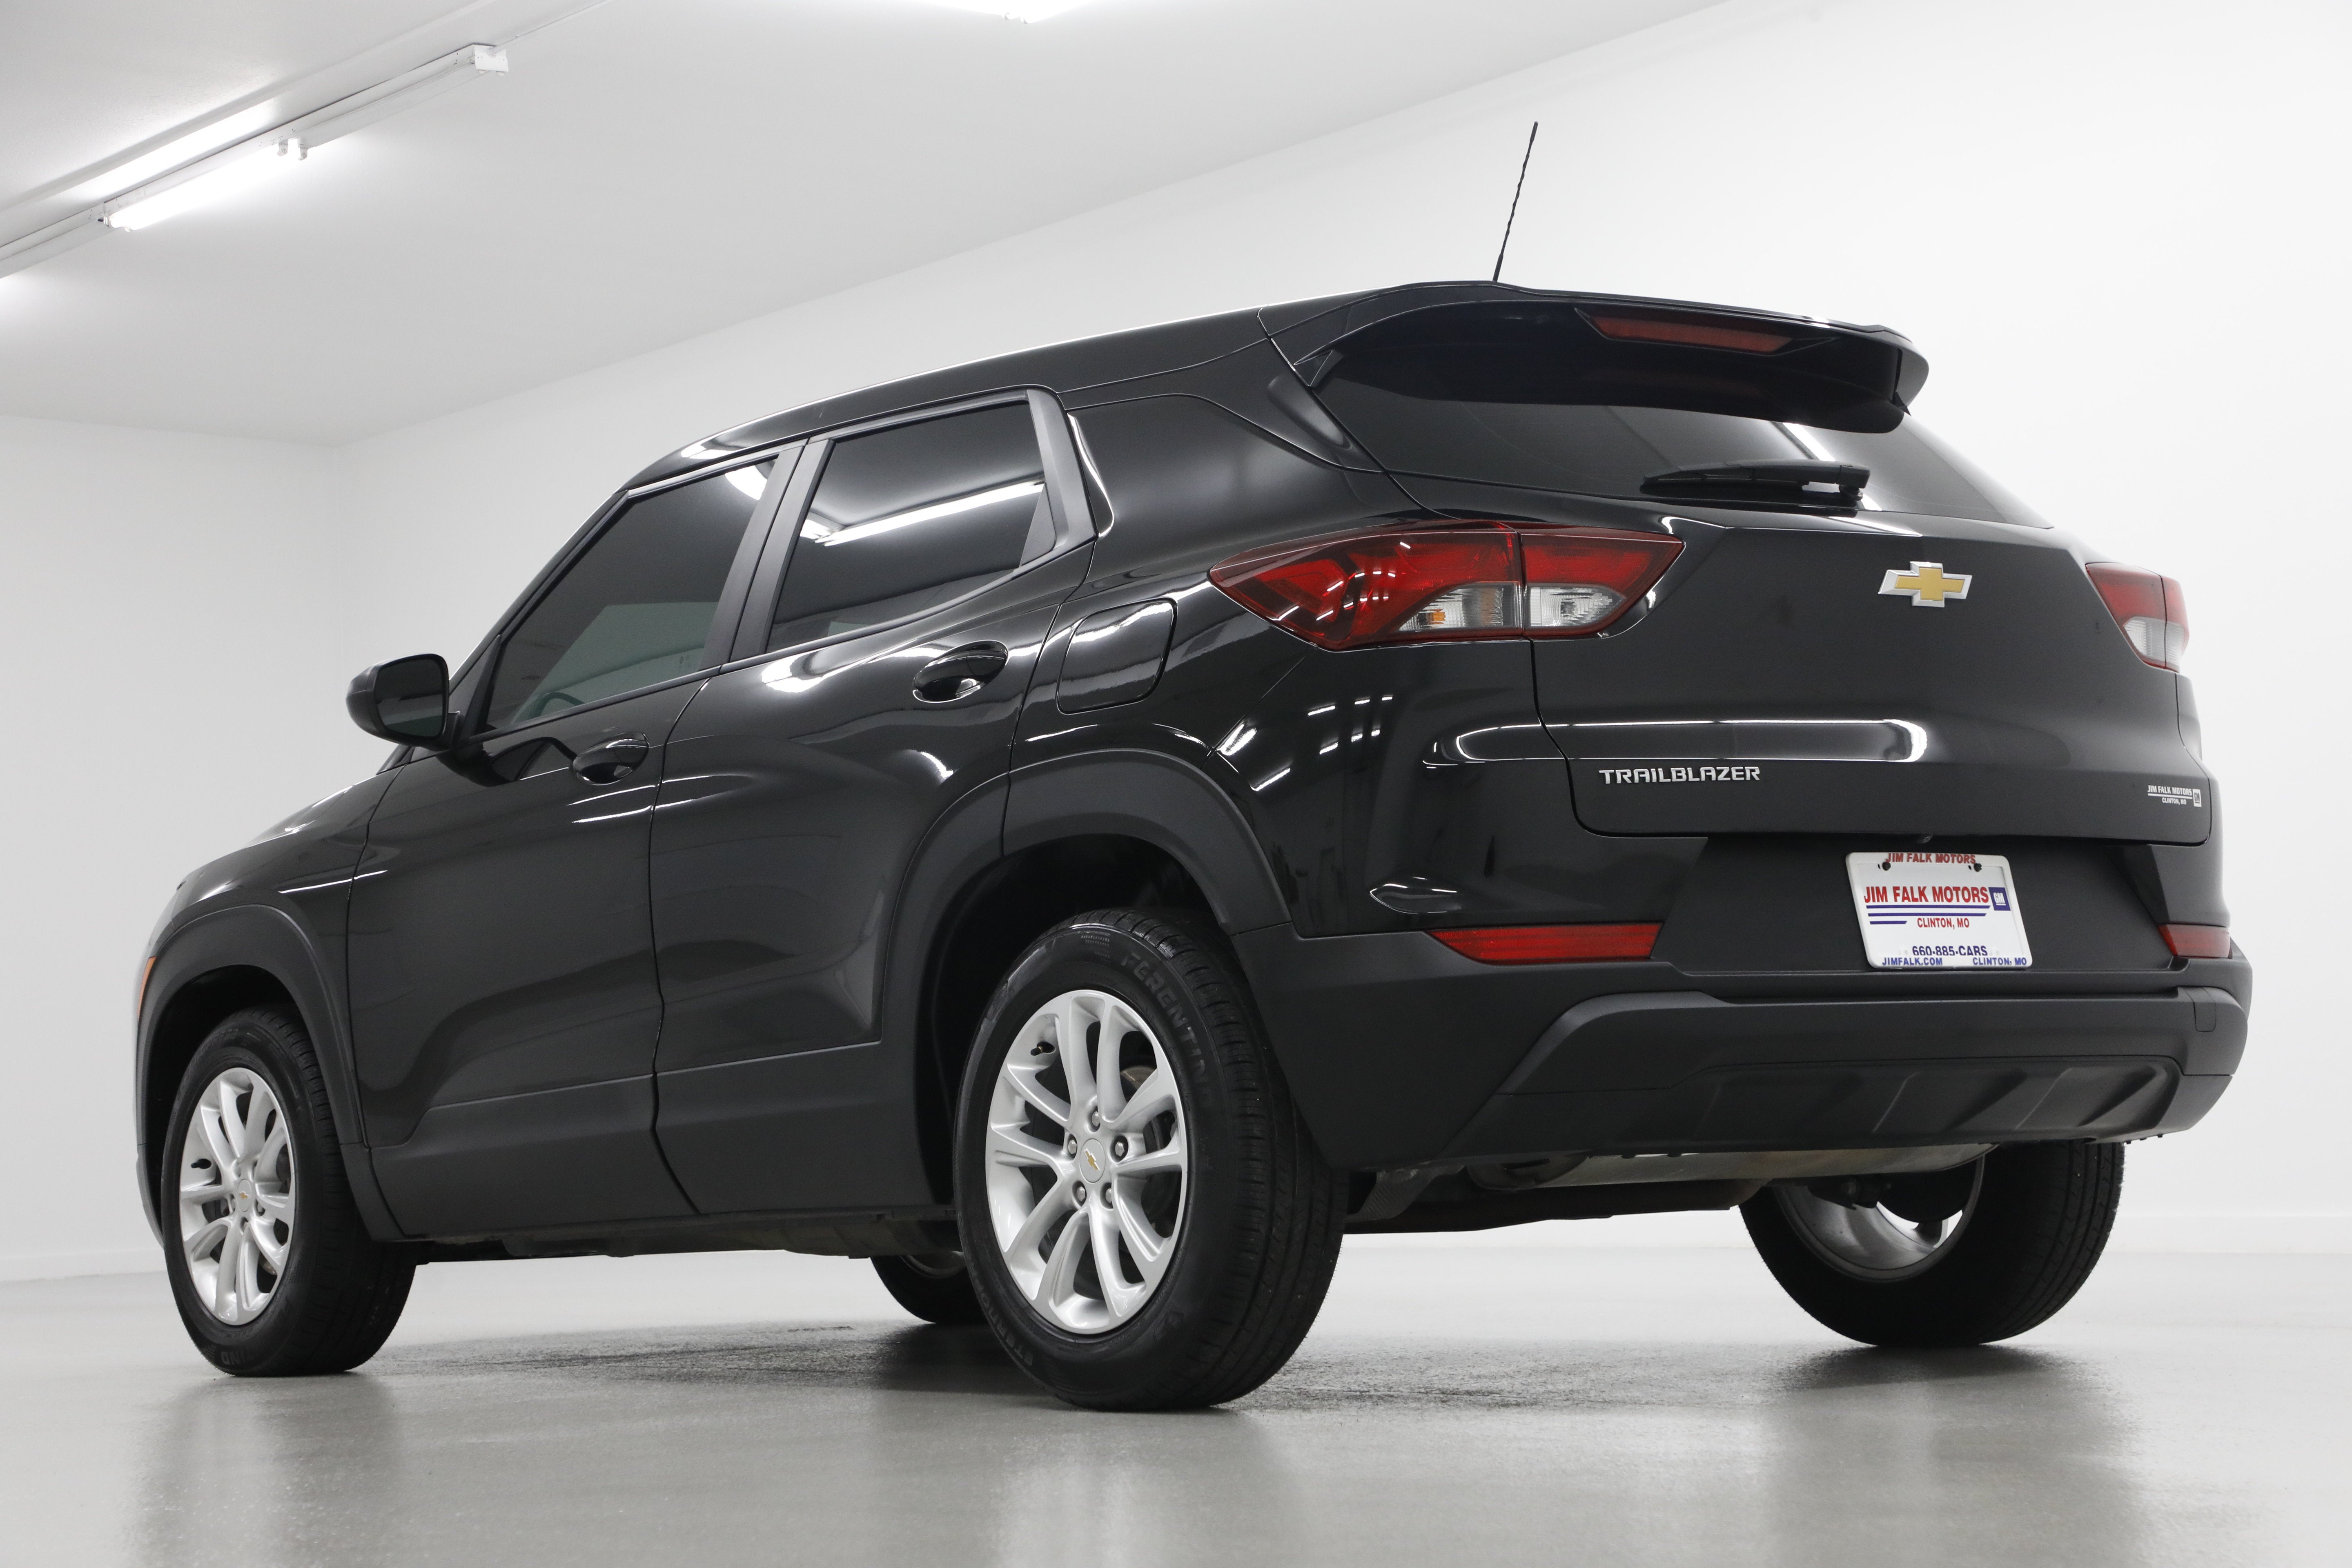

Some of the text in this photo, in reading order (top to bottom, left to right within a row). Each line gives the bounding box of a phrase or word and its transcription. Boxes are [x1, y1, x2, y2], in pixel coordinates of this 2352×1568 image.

[1599, 766, 1760, 784] TRAILBLAZER
[2172, 787, 2192, 795] MOTORS
[1885, 853, 1976, 864] JIM FALK MOTORS
[1864, 886, 1989, 903] JIM FALK MOTORS
[1917, 918, 1970, 930] CLINTON, MO
[1912, 945, 1988, 956] 660-885-CARS
[1882, 957, 2027, 966] JIMFALK.COM CLINTON, MO
